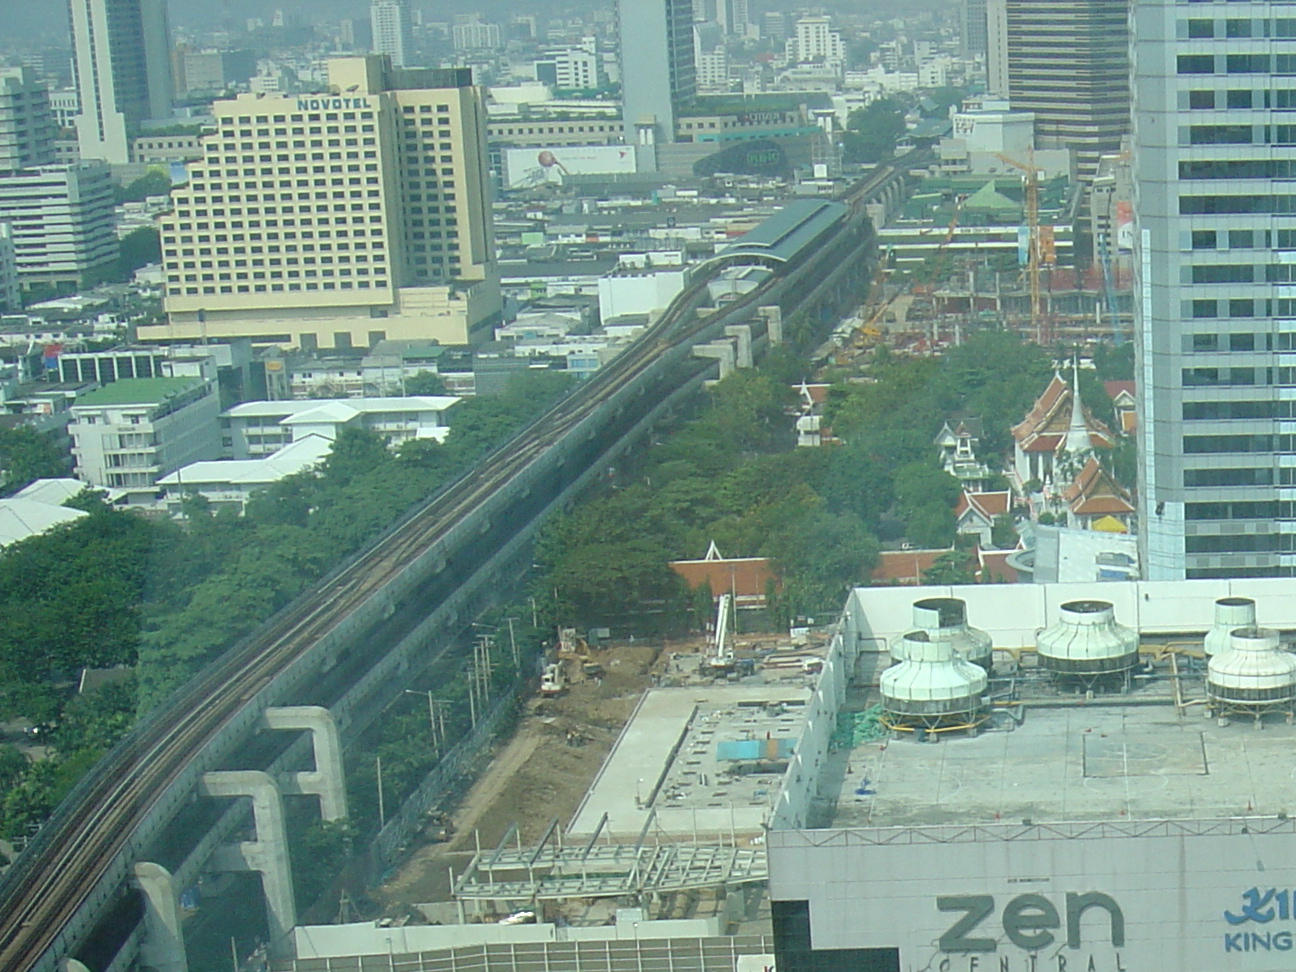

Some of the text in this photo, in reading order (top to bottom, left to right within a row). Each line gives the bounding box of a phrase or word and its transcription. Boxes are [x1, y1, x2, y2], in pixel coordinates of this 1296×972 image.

[298, 98, 371, 111] NOVOTEL
[936, 891, 1125, 953] zen
[1225, 931, 1293, 953] KING
